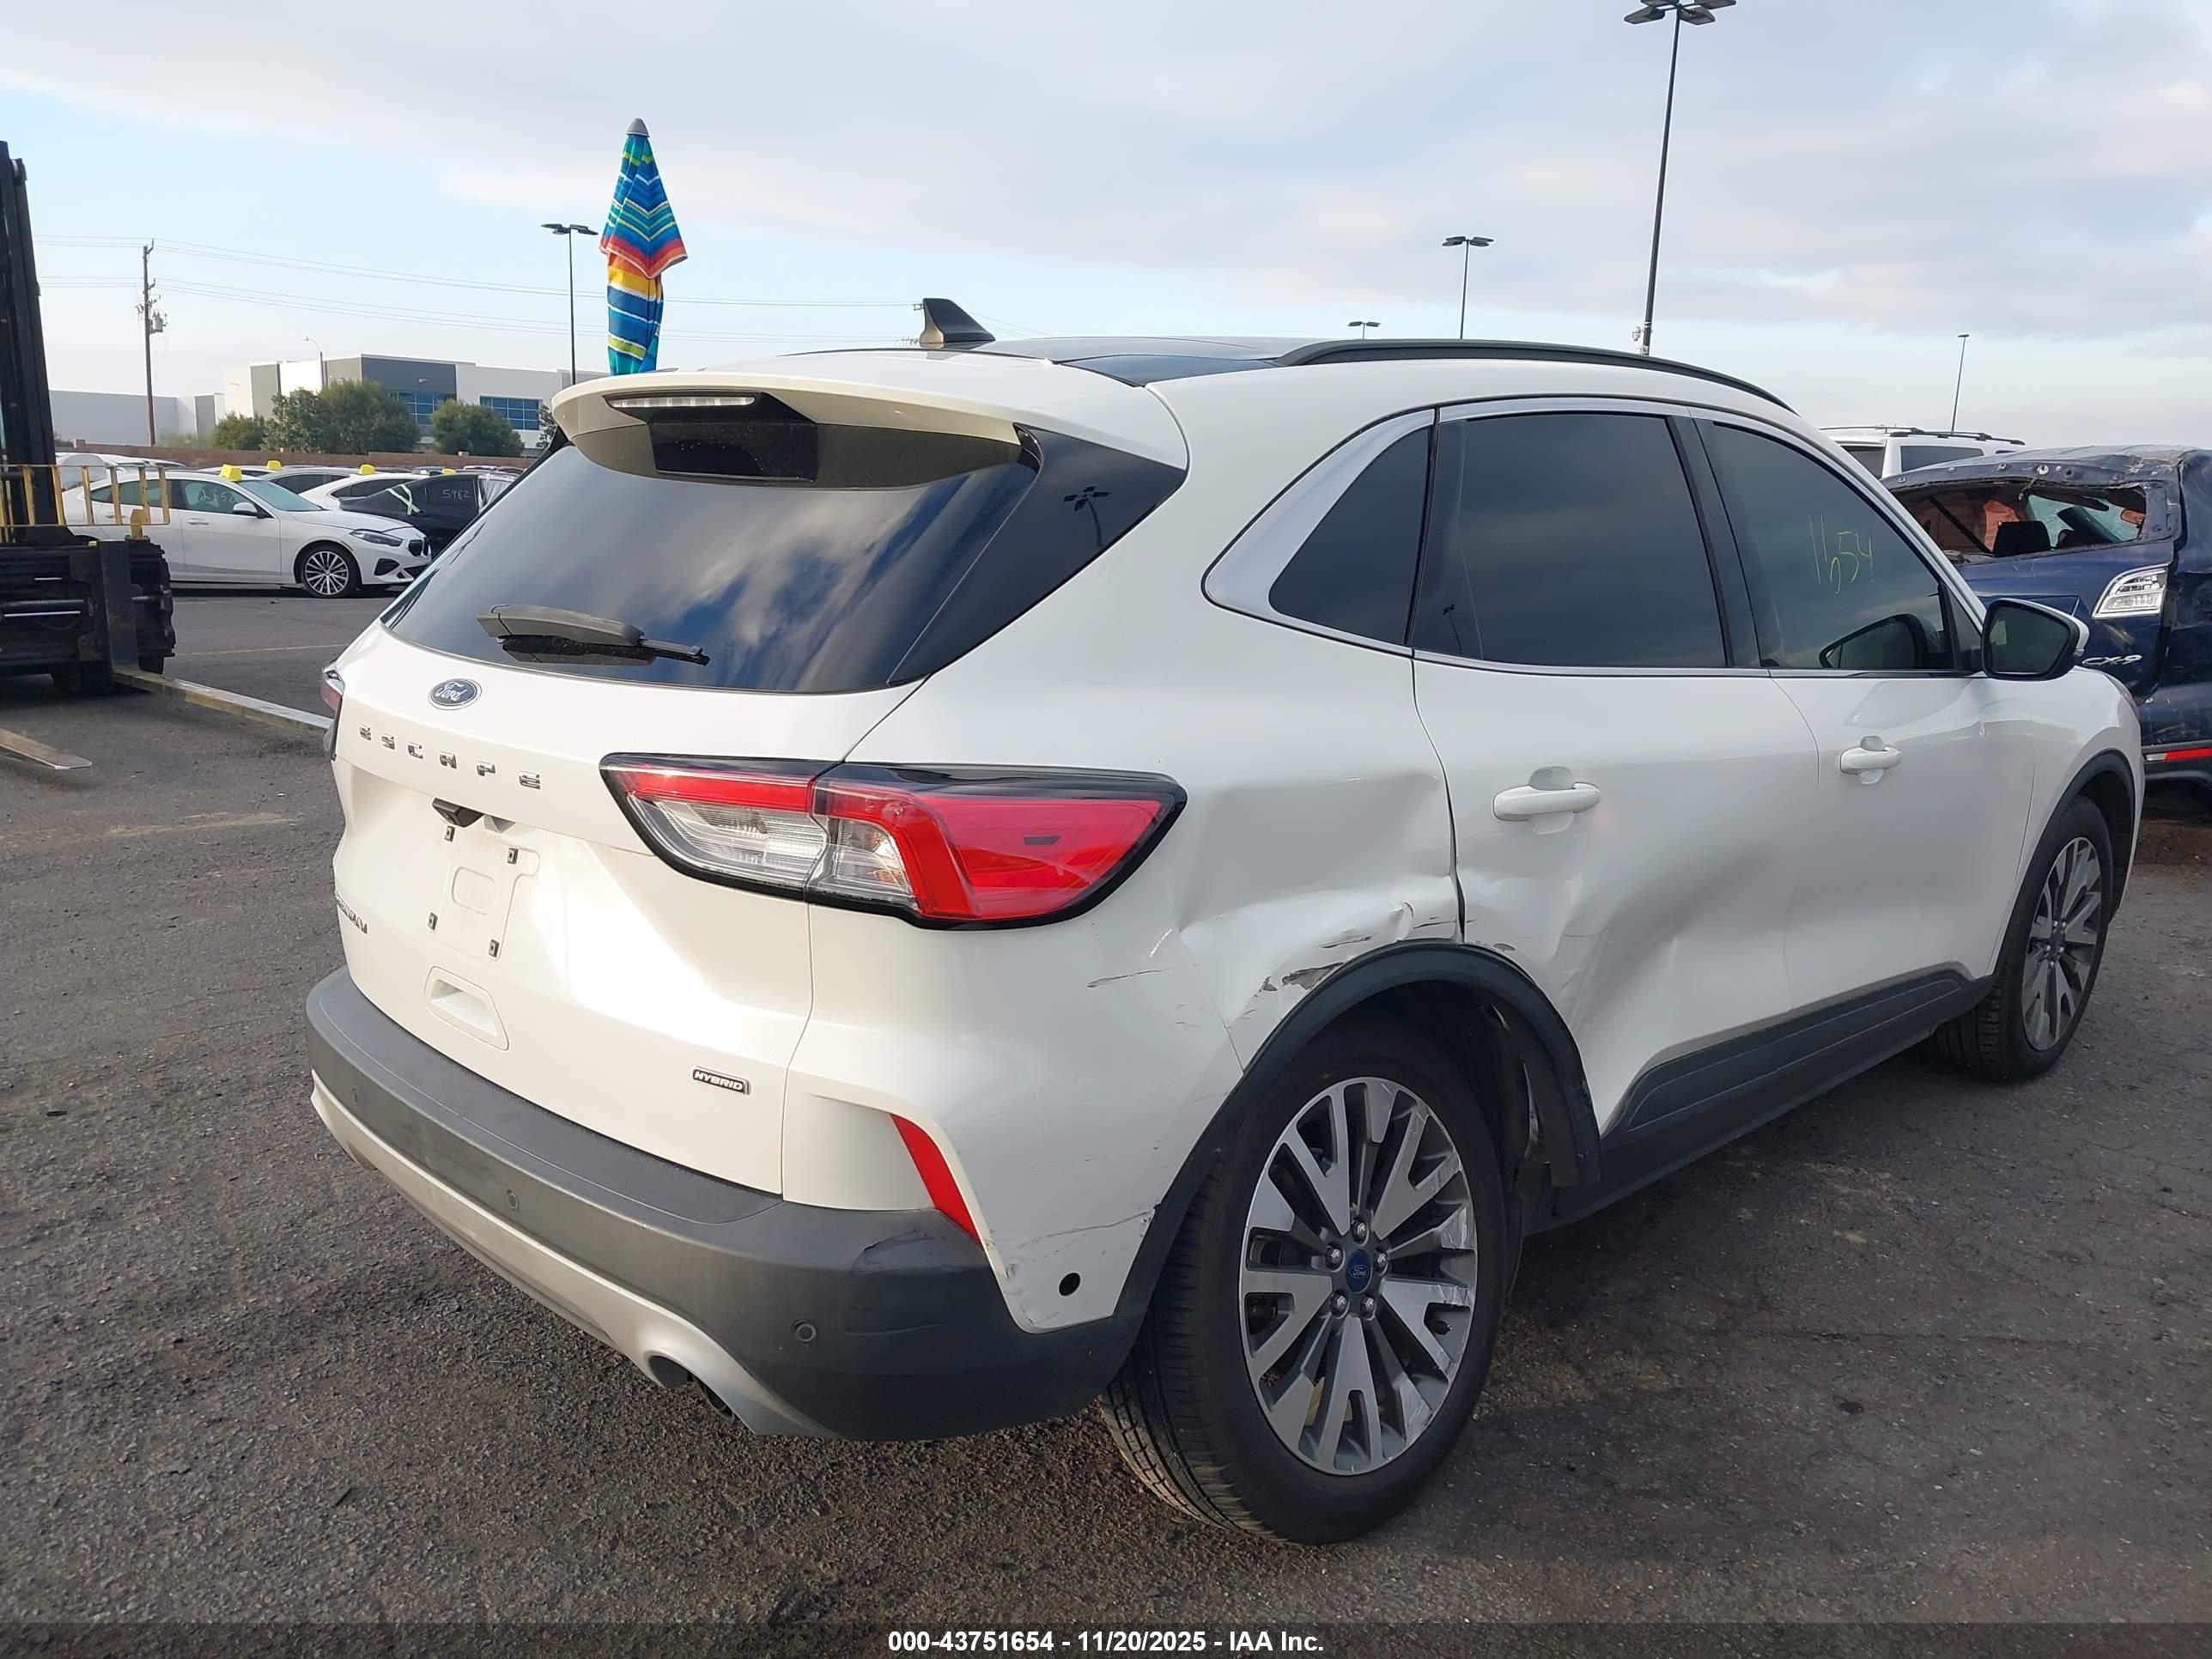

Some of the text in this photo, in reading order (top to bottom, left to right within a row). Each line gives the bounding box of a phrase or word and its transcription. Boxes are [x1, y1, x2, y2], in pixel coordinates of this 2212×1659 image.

[2081, 654, 2143, 665] CX-9
[434, 681, 467, 702] Ford
[358, 725, 542, 791] ESCAPE
[694, 1070, 744, 1091] HYBRID
